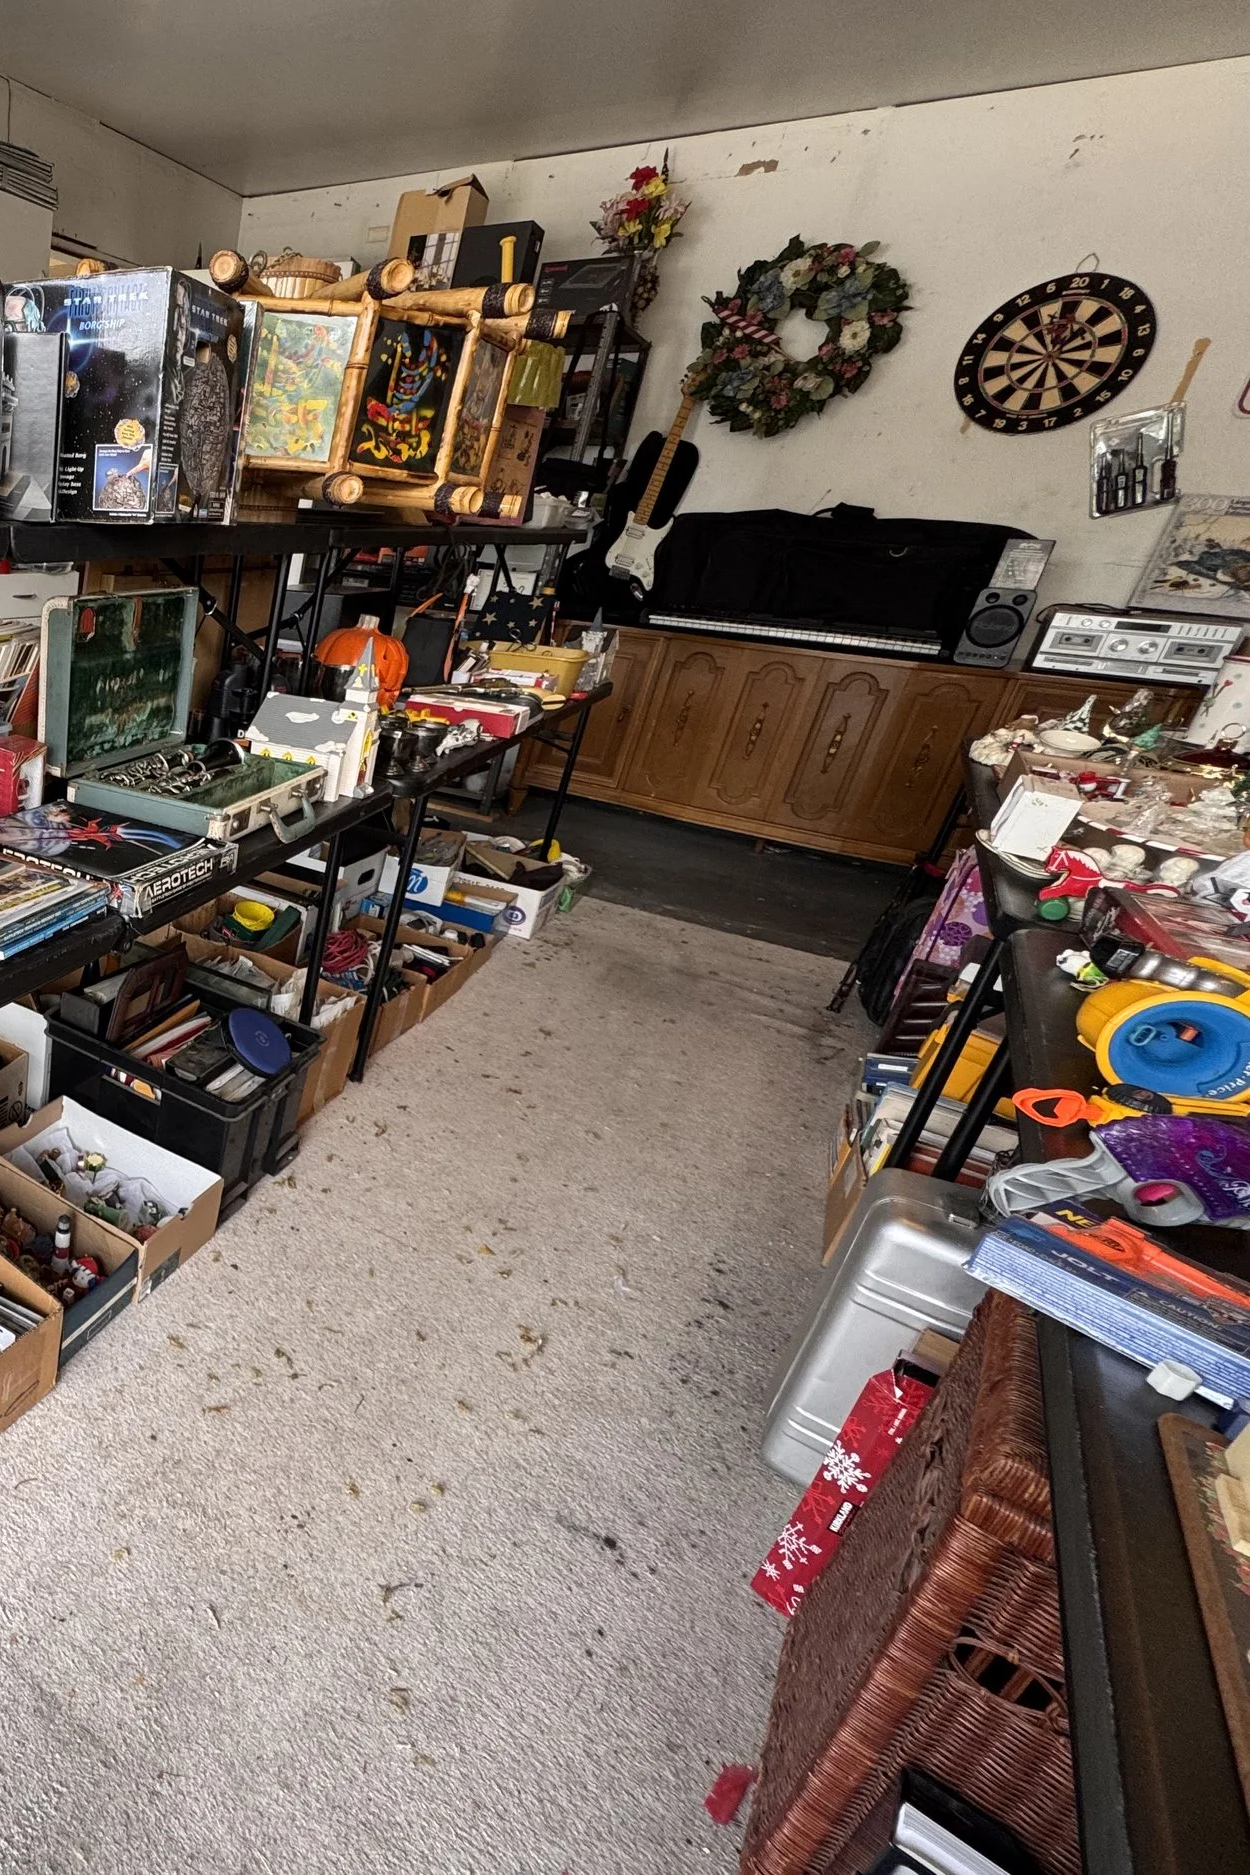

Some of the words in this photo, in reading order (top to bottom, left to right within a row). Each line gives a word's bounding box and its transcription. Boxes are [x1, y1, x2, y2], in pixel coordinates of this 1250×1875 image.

[1070, 277, 1090, 288] 20
[1100, 278, 1110, 290] 1
[64, 296, 102, 306] STAR
[108, 292, 149, 302] TREK
[1118, 286, 1136, 300] 18
[1015, 294, 1032, 306] 12
[192, 305, 210, 318] STAR
[1134, 304, 1146, 314] 4
[79, 319, 102, 331] BORG
[104, 318, 125, 329] SHIP
[992, 313, 1005, 323] 9
[1138, 323, 1151, 337] 13
[972, 333, 987, 346] 14
[1133, 349, 1145, 358] 6
[962, 355, 975, 366] 11
[958, 377, 970, 386] 8
[1117, 369, 1133, 382] 10
[962, 394, 975, 407] 16
[1095, 390, 1112, 403] 15
[975, 410, 987, 418] 7
[1073, 408, 1083, 417] 2
[992, 418, 1006, 429] 19
[1018, 421, 1028, 431] 3
[1043, 417, 1058, 428] 17
[145, 858, 213, 900] AEROTECH
[1055, 1209, 1097, 1229] NE
[1050, 1249, 1122, 1284] JOLT
[1158, 1300, 1221, 1329] CAUTION
[829, 1501, 853, 1533] KIRKLAND
